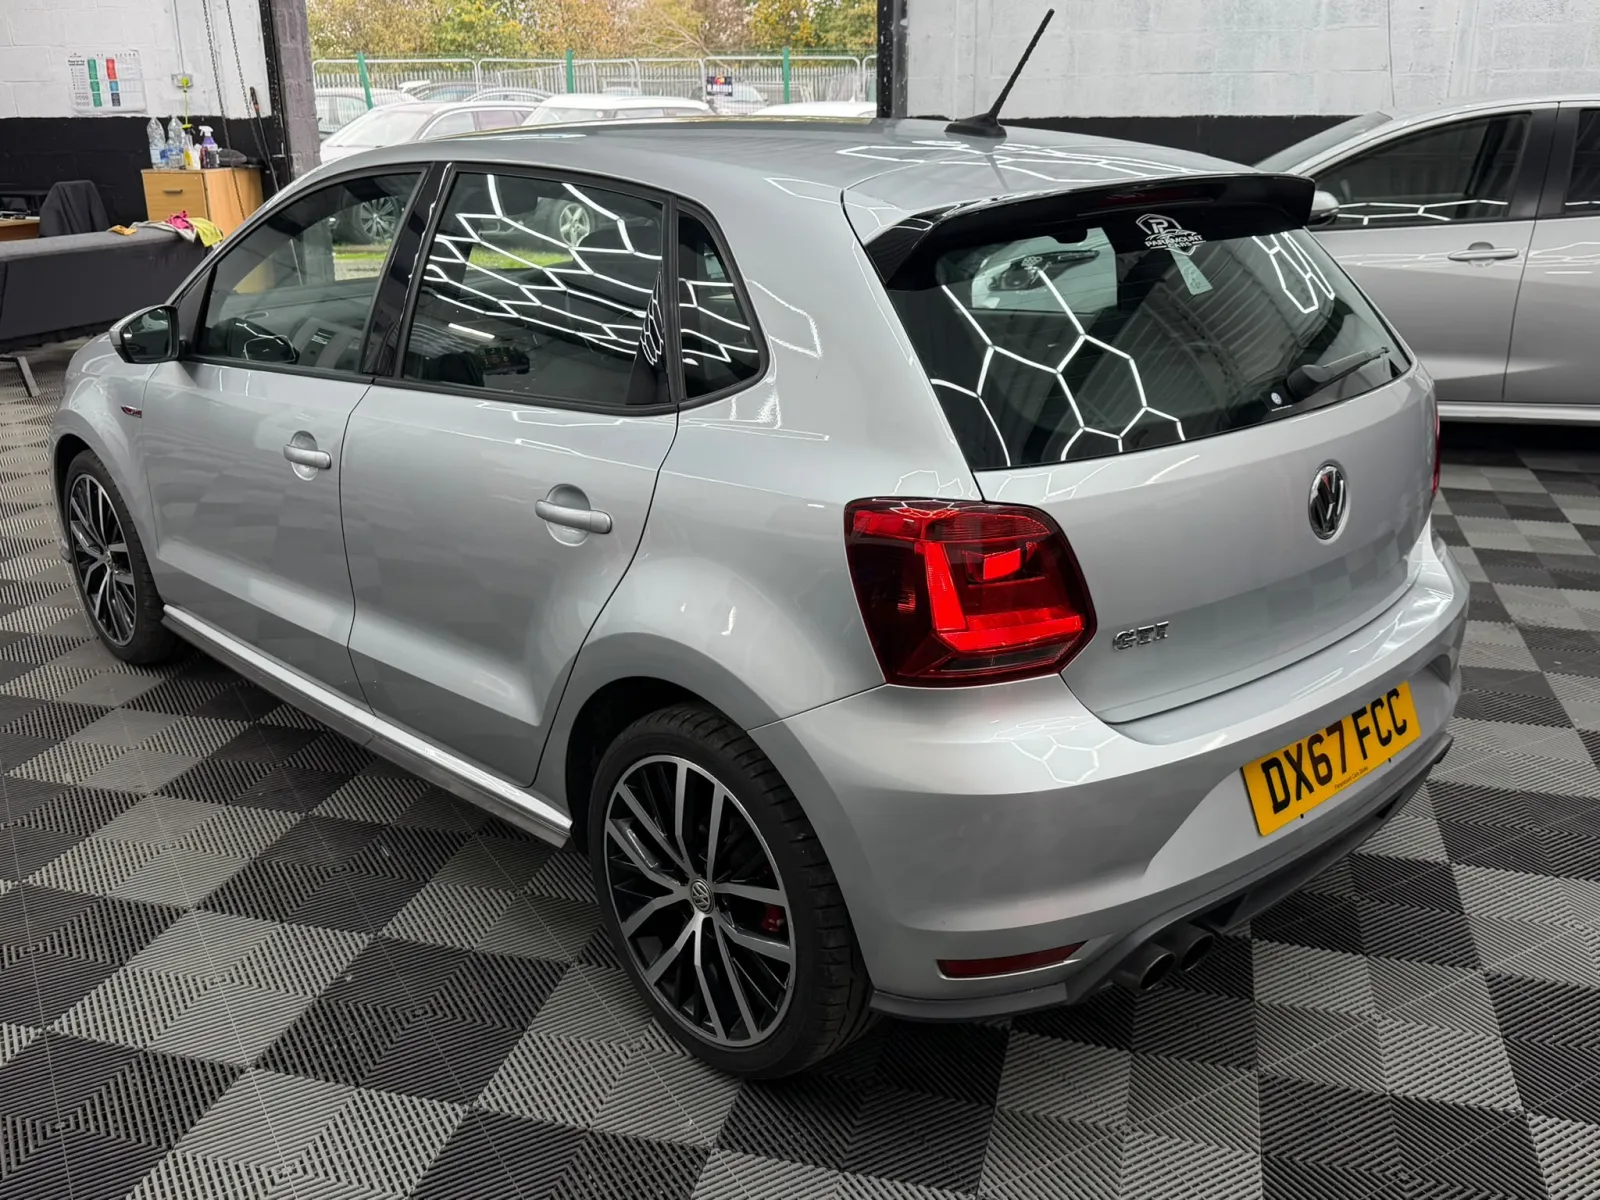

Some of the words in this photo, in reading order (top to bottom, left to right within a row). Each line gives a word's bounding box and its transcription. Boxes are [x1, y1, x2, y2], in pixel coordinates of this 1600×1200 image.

[1144, 234, 1203, 247] PARAMOUNT
[1112, 620, 1169, 651] GTI
[1260, 719, 1347, 815] DX67
[1351, 687, 1408, 761] FCC
